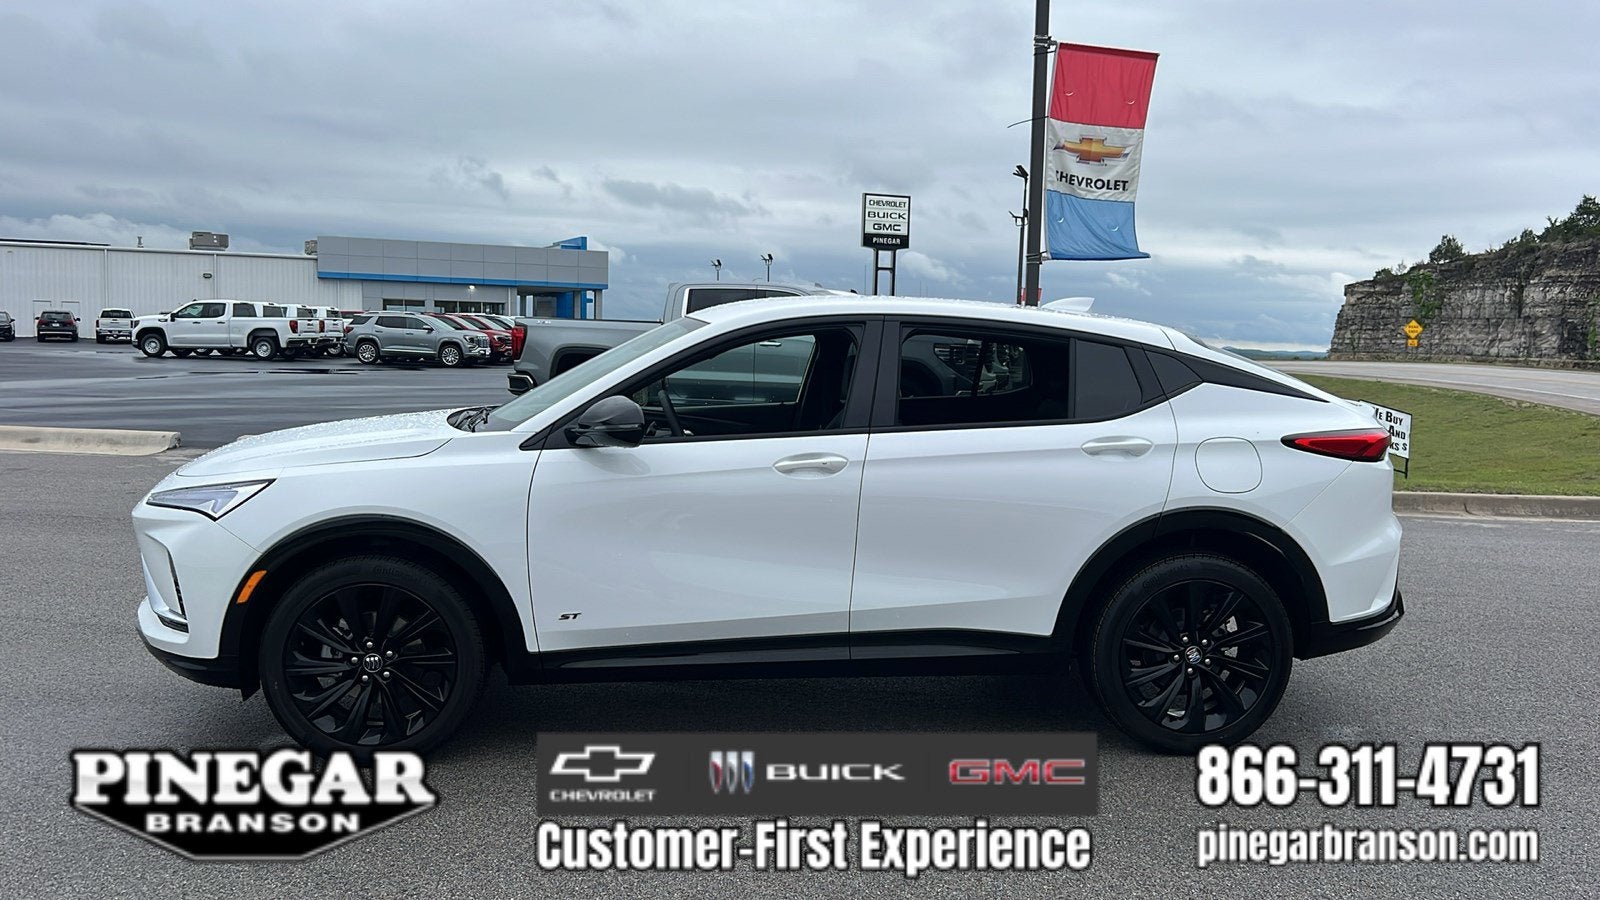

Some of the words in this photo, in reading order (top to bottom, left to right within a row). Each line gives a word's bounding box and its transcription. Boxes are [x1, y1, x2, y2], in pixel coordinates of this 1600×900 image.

[868, 199, 907, 208] CHEVROLET
[867, 211, 906, 220] BUICK
[873, 223, 901, 231] GMC
[872, 237, 901, 245] PINEGAR
[558, 612, 582, 621] ST
